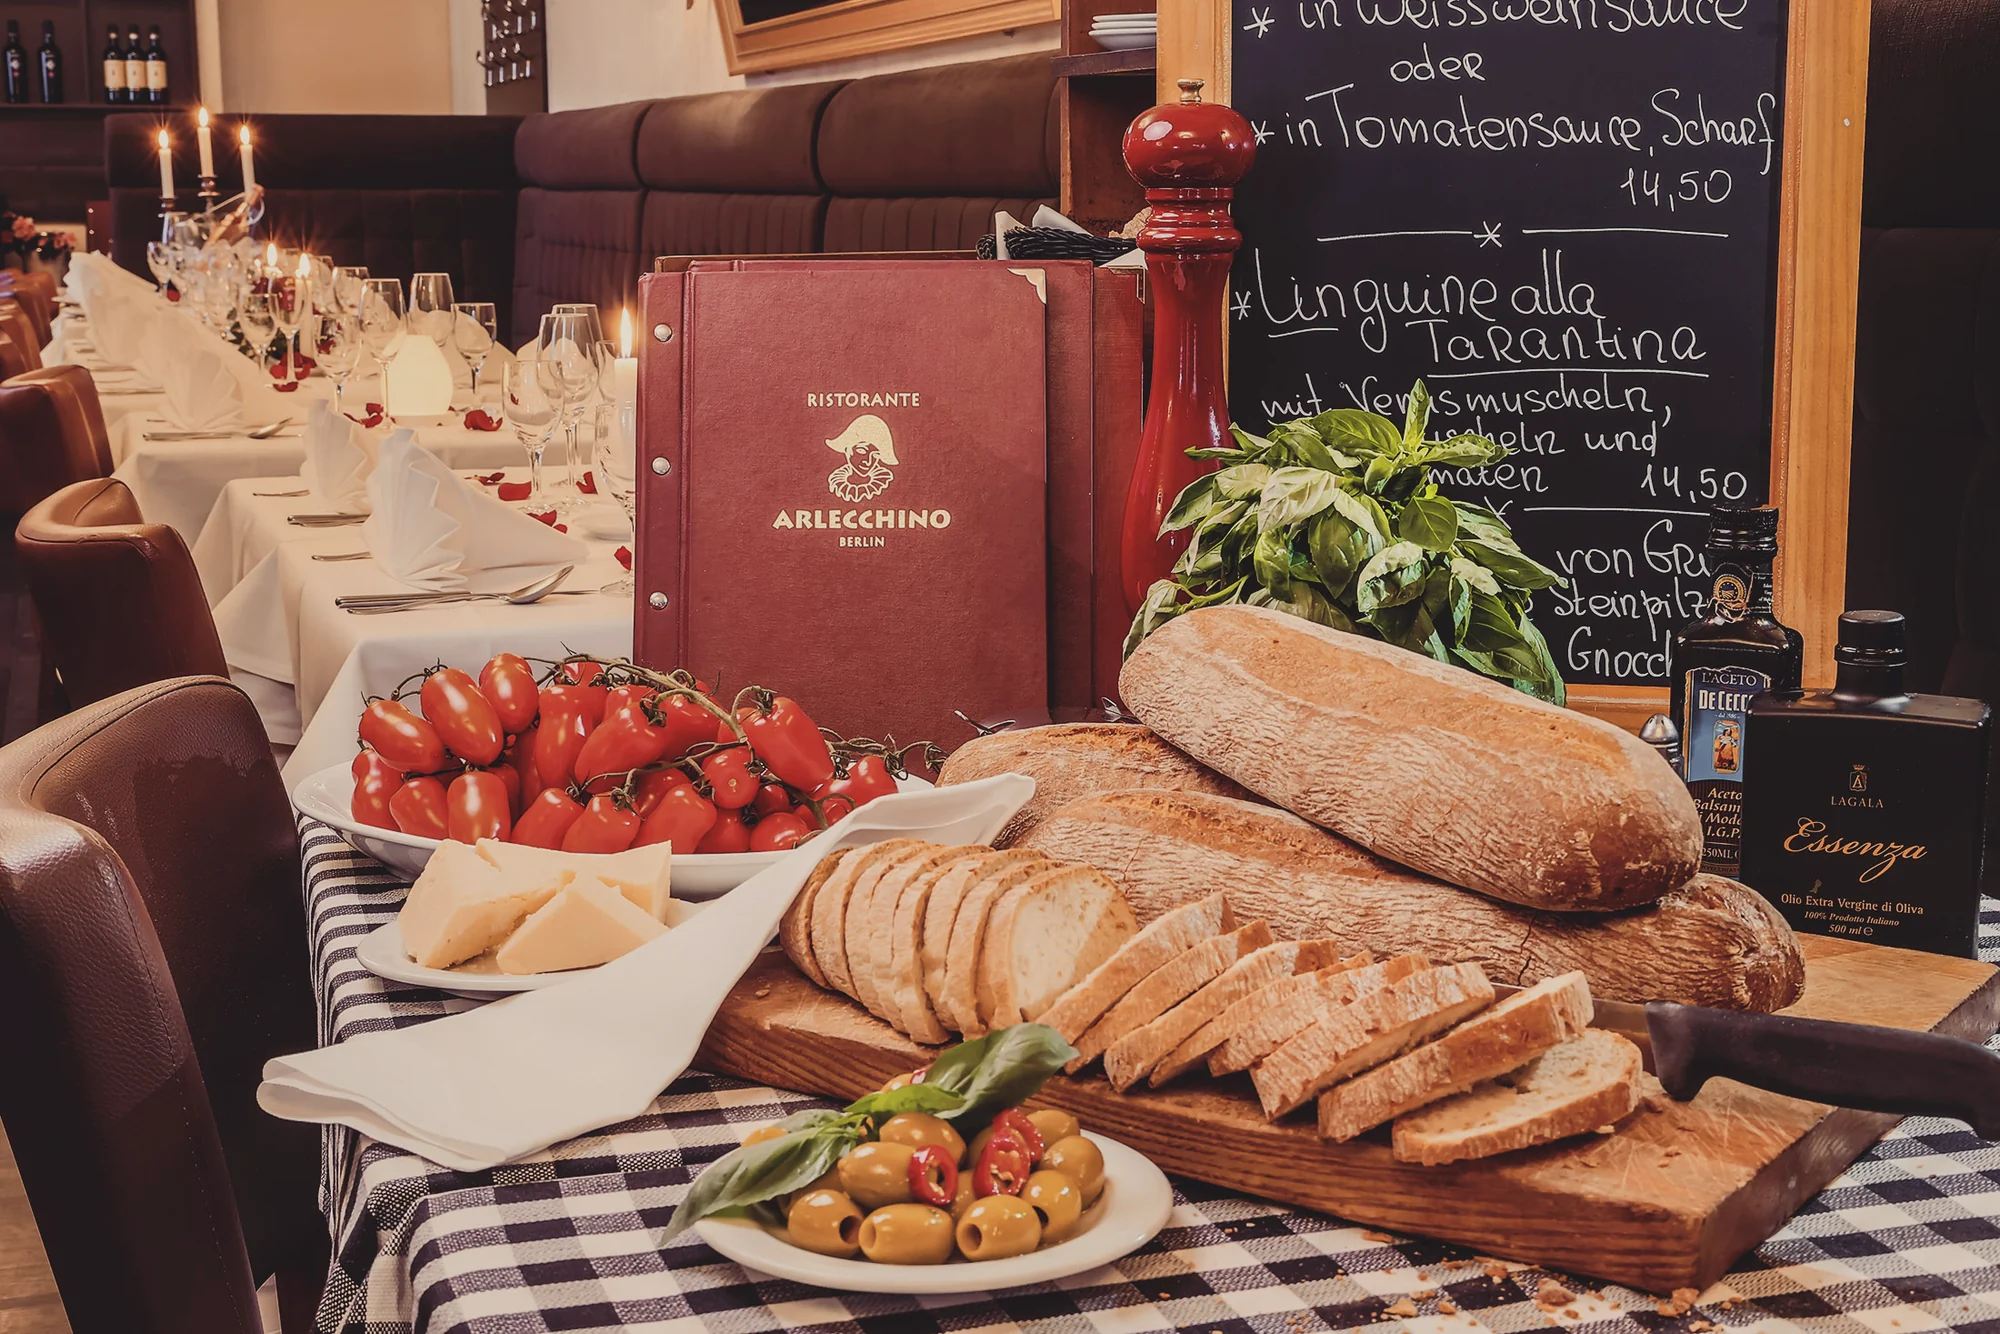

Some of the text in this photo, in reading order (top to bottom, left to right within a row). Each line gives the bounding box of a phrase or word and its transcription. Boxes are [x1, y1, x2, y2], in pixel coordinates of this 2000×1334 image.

[1389, 42, 1486, 83] oder
[1286, 112, 1323, 147] in
[1620, 167, 1733, 213] 14,50
[1254, 246, 1607, 353] Linguine alla
[806, 391, 921, 408] RISTORANTE
[1260, 372, 1332, 418] mit
[1584, 419, 1658, 458] und
[1427, 462, 1749, 504] maten 14,50
[771, 508, 952, 531] ARLECCHINO
[838, 536, 886, 548] BERLIN
[1555, 547, 1636, 578] von
[1567, 625, 1673, 679] Gnocch
[1701, 672, 1757, 687] L'ACETO
[1698, 689, 1717, 710] DE
[1707, 786, 1742, 801] Aceto
[1830, 795, 1884, 809] LAGALA
[1693, 798, 1742, 814] Balsam
[1783, 816, 1928, 884] Essenza
[1780, 893, 1924, 915] Olio Extra Vergine di Oliva
[1804, 910, 1900, 926] 100% Prodotto Italiano
[1828, 923, 1847, 934] 500
[1849, 924, 1862, 935] ml
